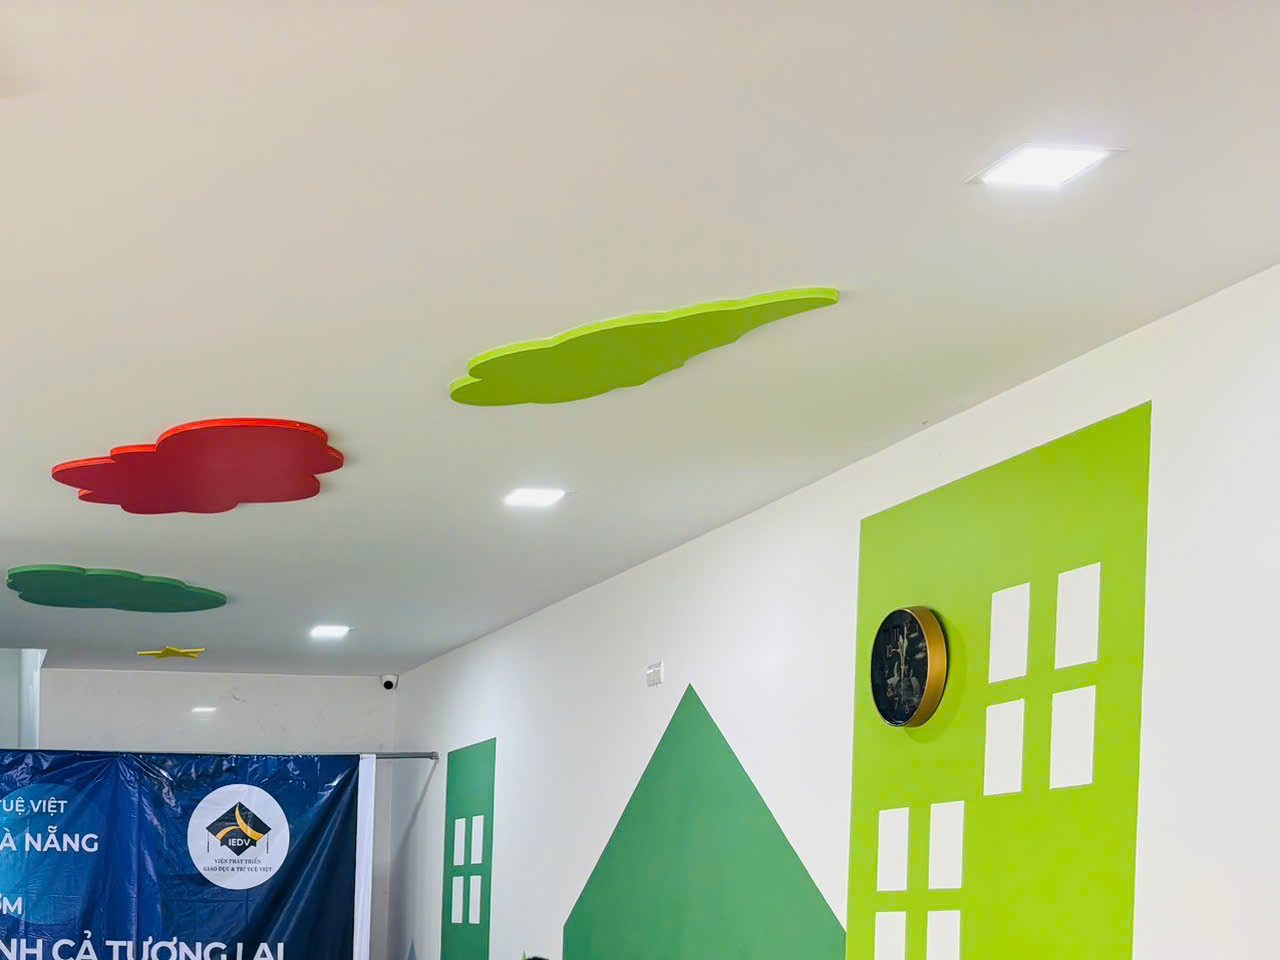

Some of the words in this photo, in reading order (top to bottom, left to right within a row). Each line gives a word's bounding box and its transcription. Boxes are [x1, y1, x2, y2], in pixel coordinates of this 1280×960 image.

[29, 797, 68, 816] VIỆT
[25, 826, 98, 852] NẴNG
[228, 838, 251, 846] IEDV
